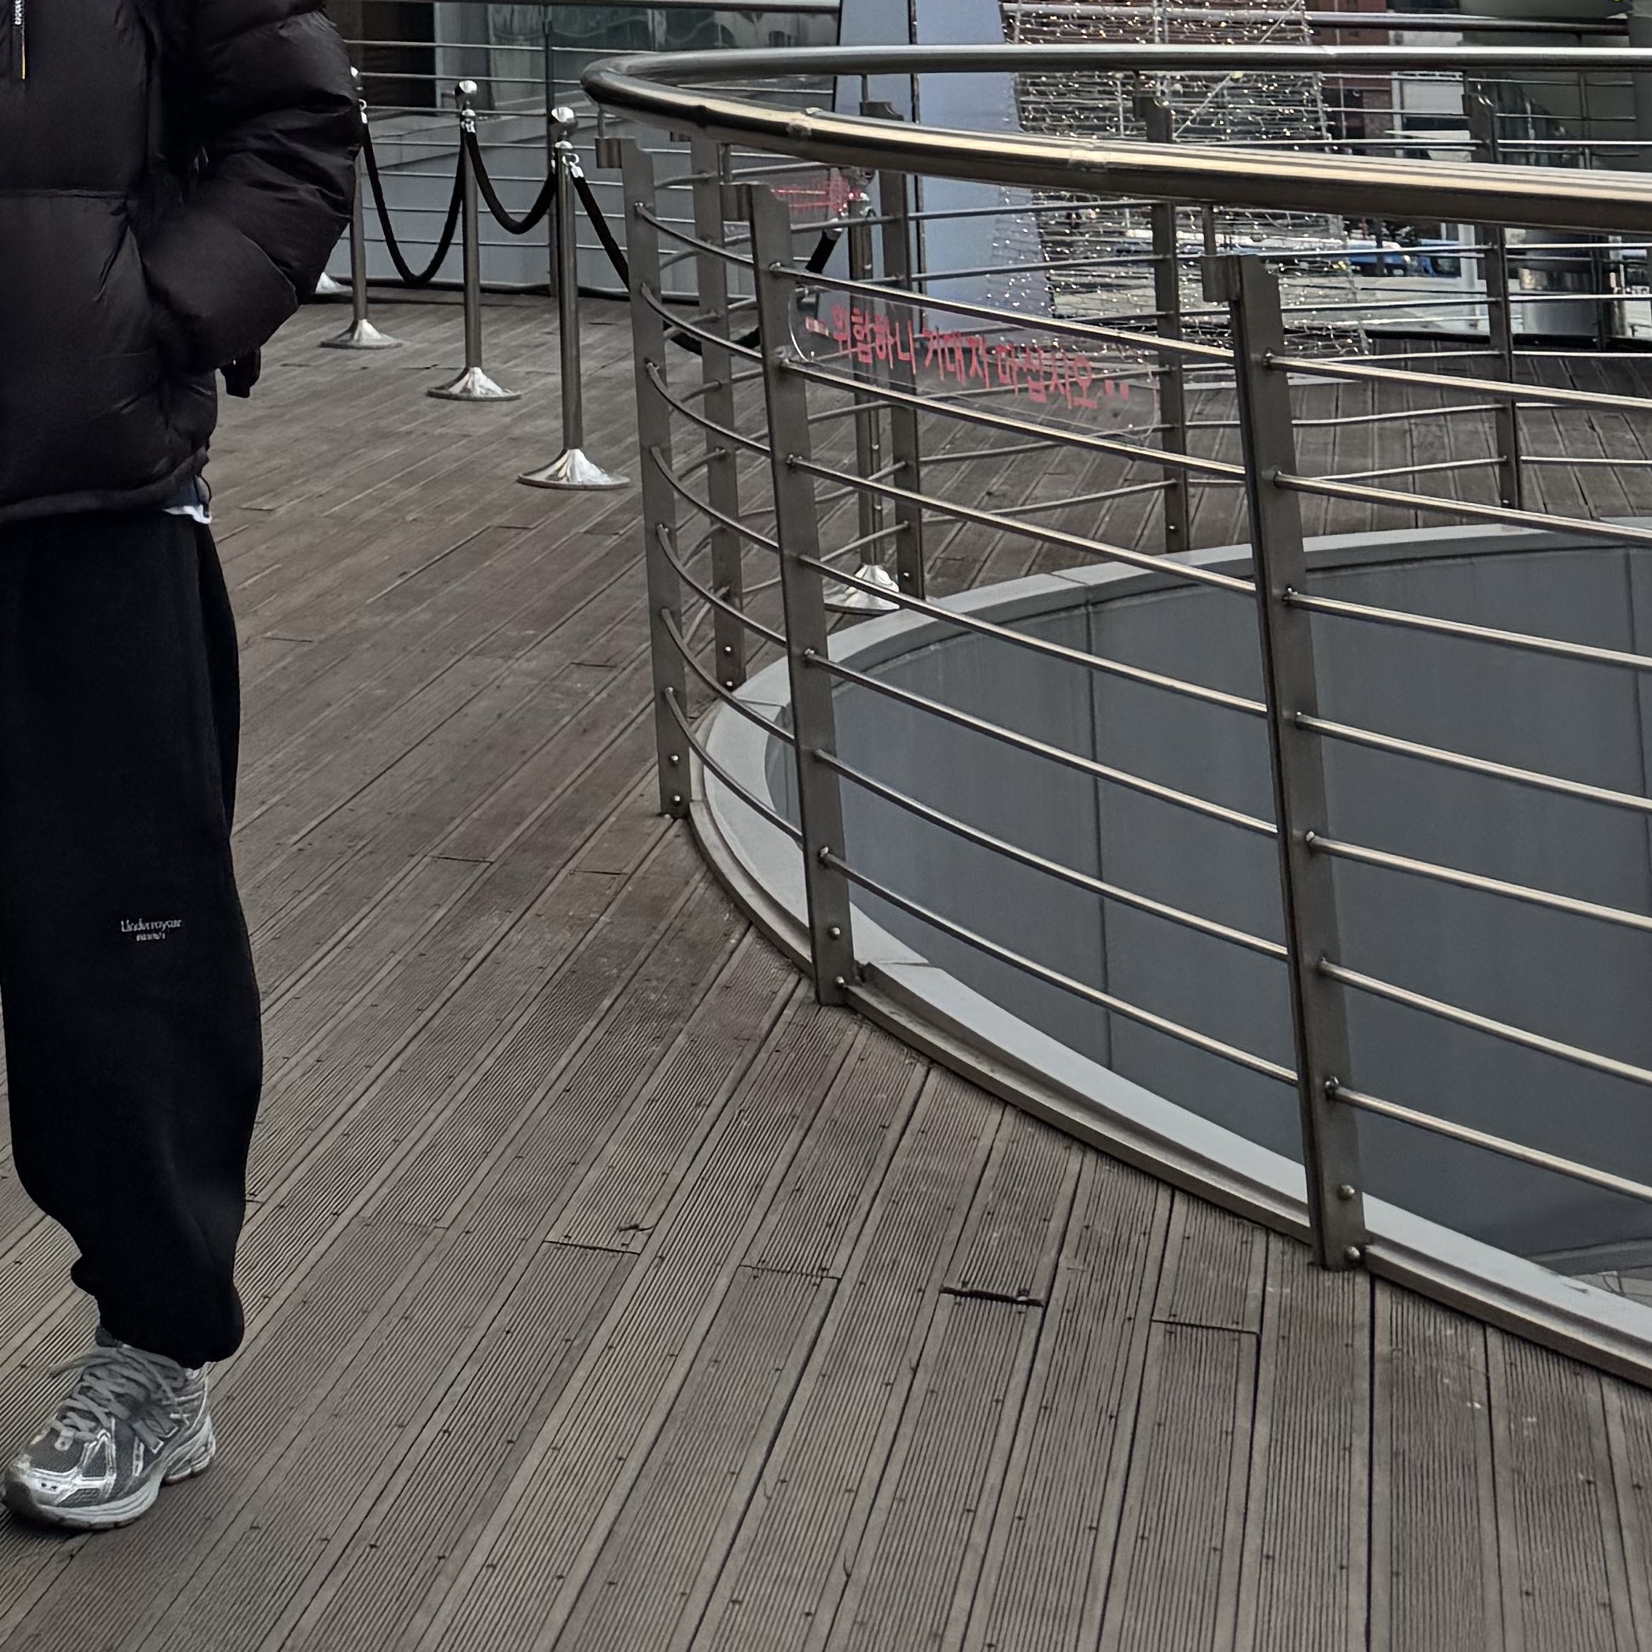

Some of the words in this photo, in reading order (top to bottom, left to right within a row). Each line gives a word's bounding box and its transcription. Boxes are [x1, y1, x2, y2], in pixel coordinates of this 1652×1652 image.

[831, 303, 917, 375] 위험하니
[922, 326, 991, 390] 기대지
[995, 341, 1099, 410] 마십시오
